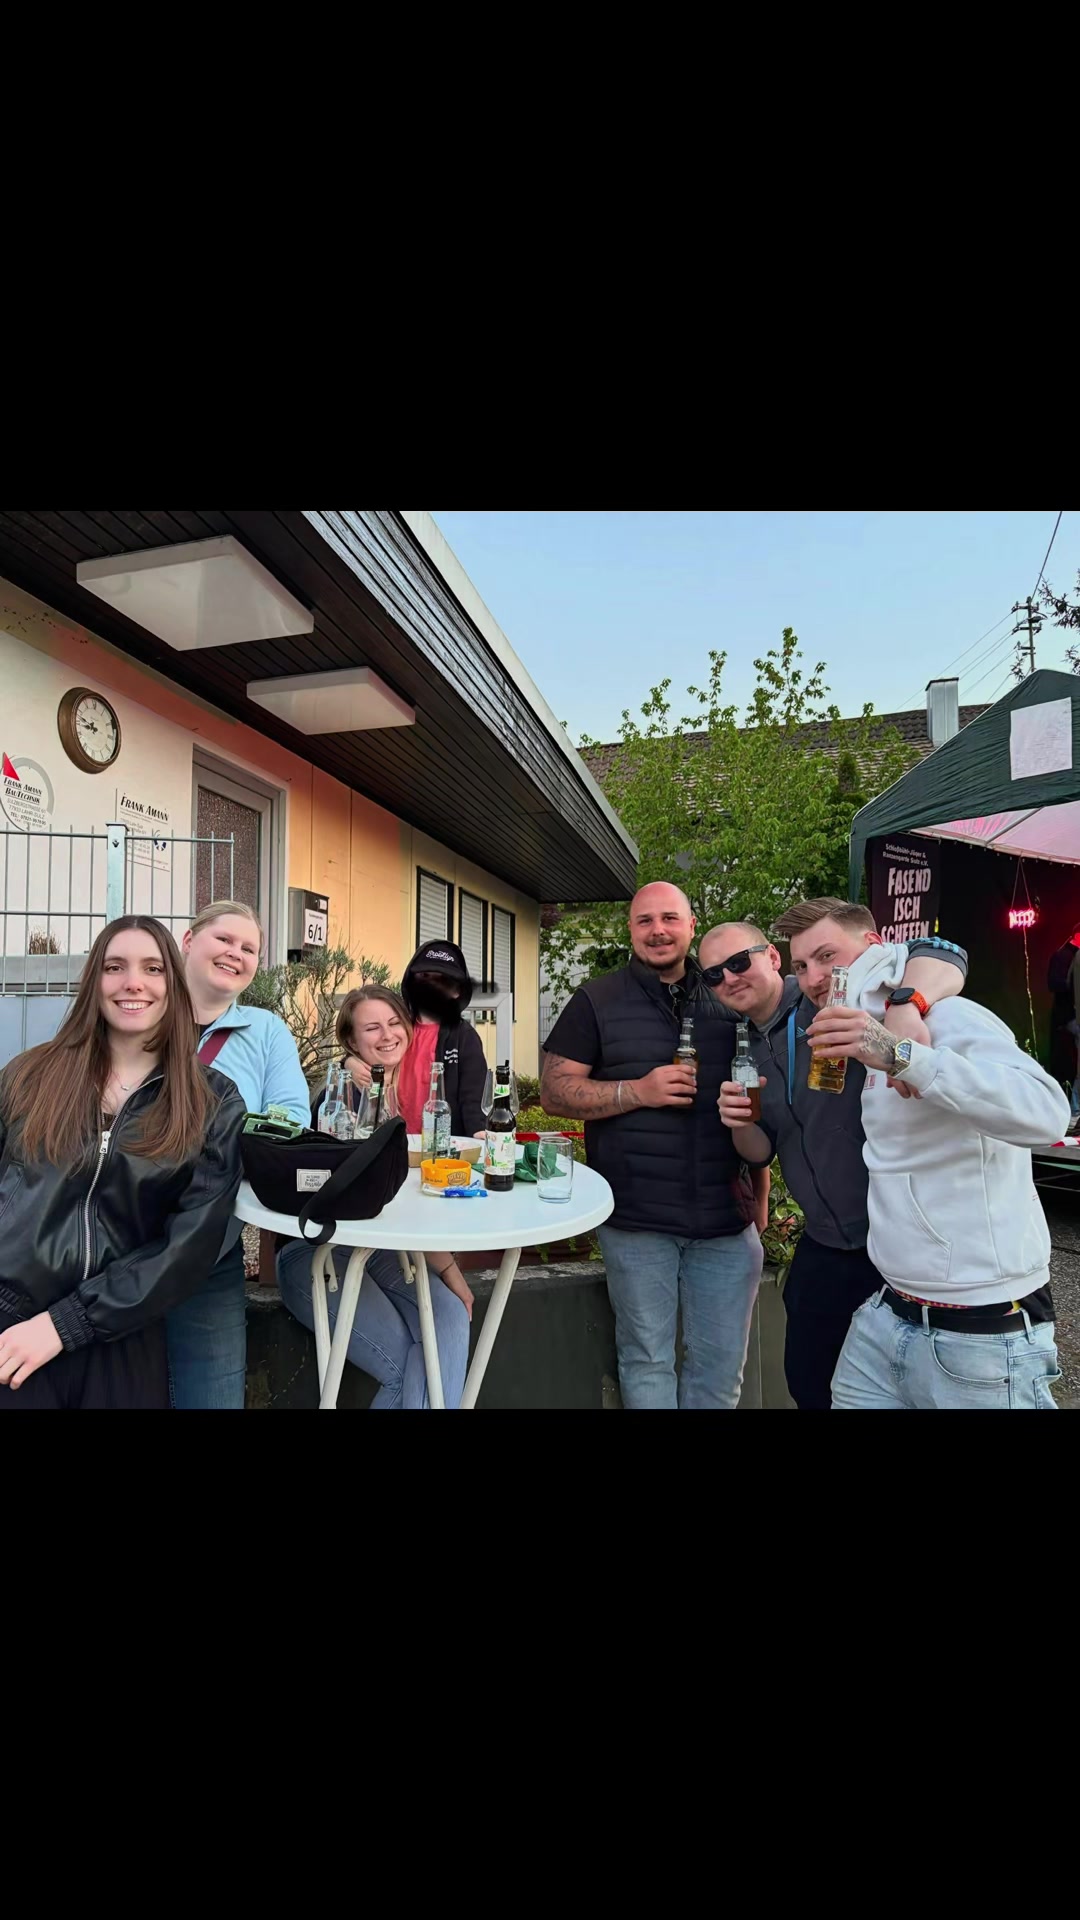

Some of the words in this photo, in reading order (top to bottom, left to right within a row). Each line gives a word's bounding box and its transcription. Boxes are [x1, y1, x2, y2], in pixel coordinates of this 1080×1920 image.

[120, 796, 144, 813] FRANK
[145, 805, 169, 821] AMANN
[887, 867, 931, 896] FASEND
[893, 895, 920, 922] ISCH
[308, 924, 322, 942] 6/1
